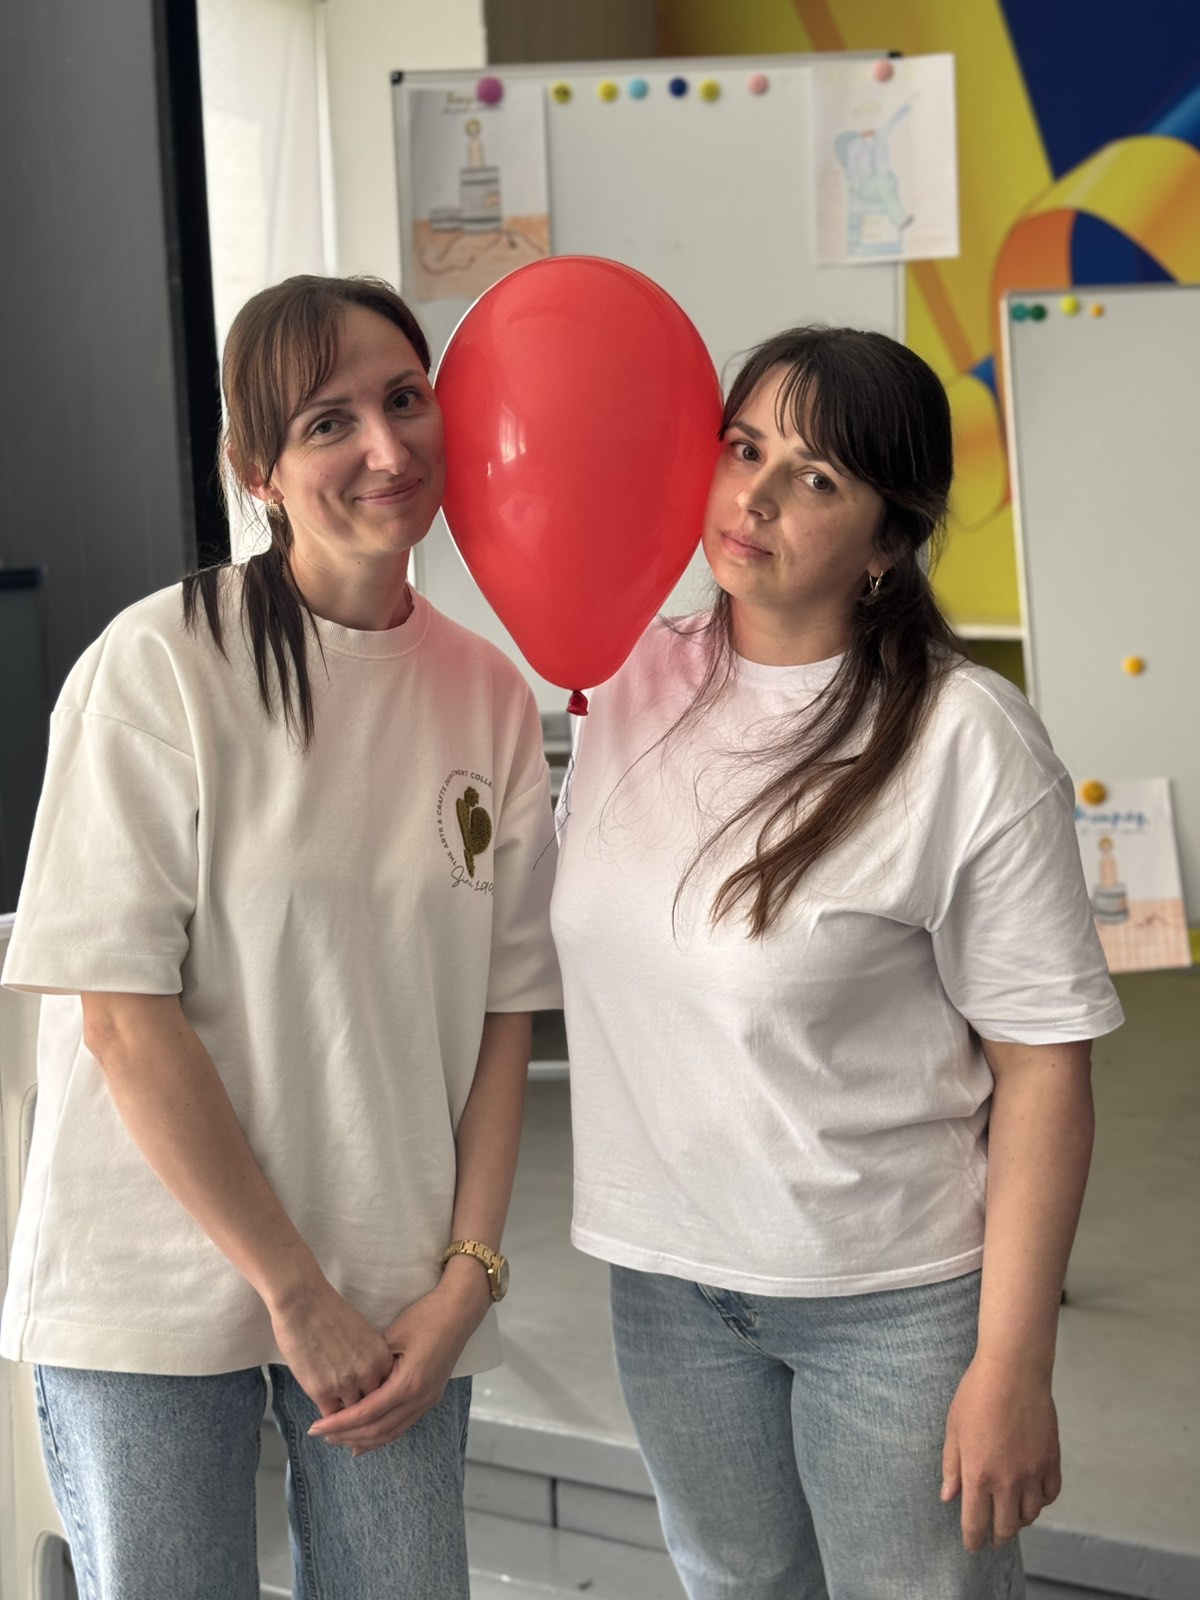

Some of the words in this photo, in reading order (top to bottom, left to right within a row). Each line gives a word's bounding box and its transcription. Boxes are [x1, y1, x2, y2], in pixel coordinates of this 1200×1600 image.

[436, 785, 448, 816] CRAFTS
[438, 827, 450, 849] ARTS
[446, 849, 458, 867] THE
